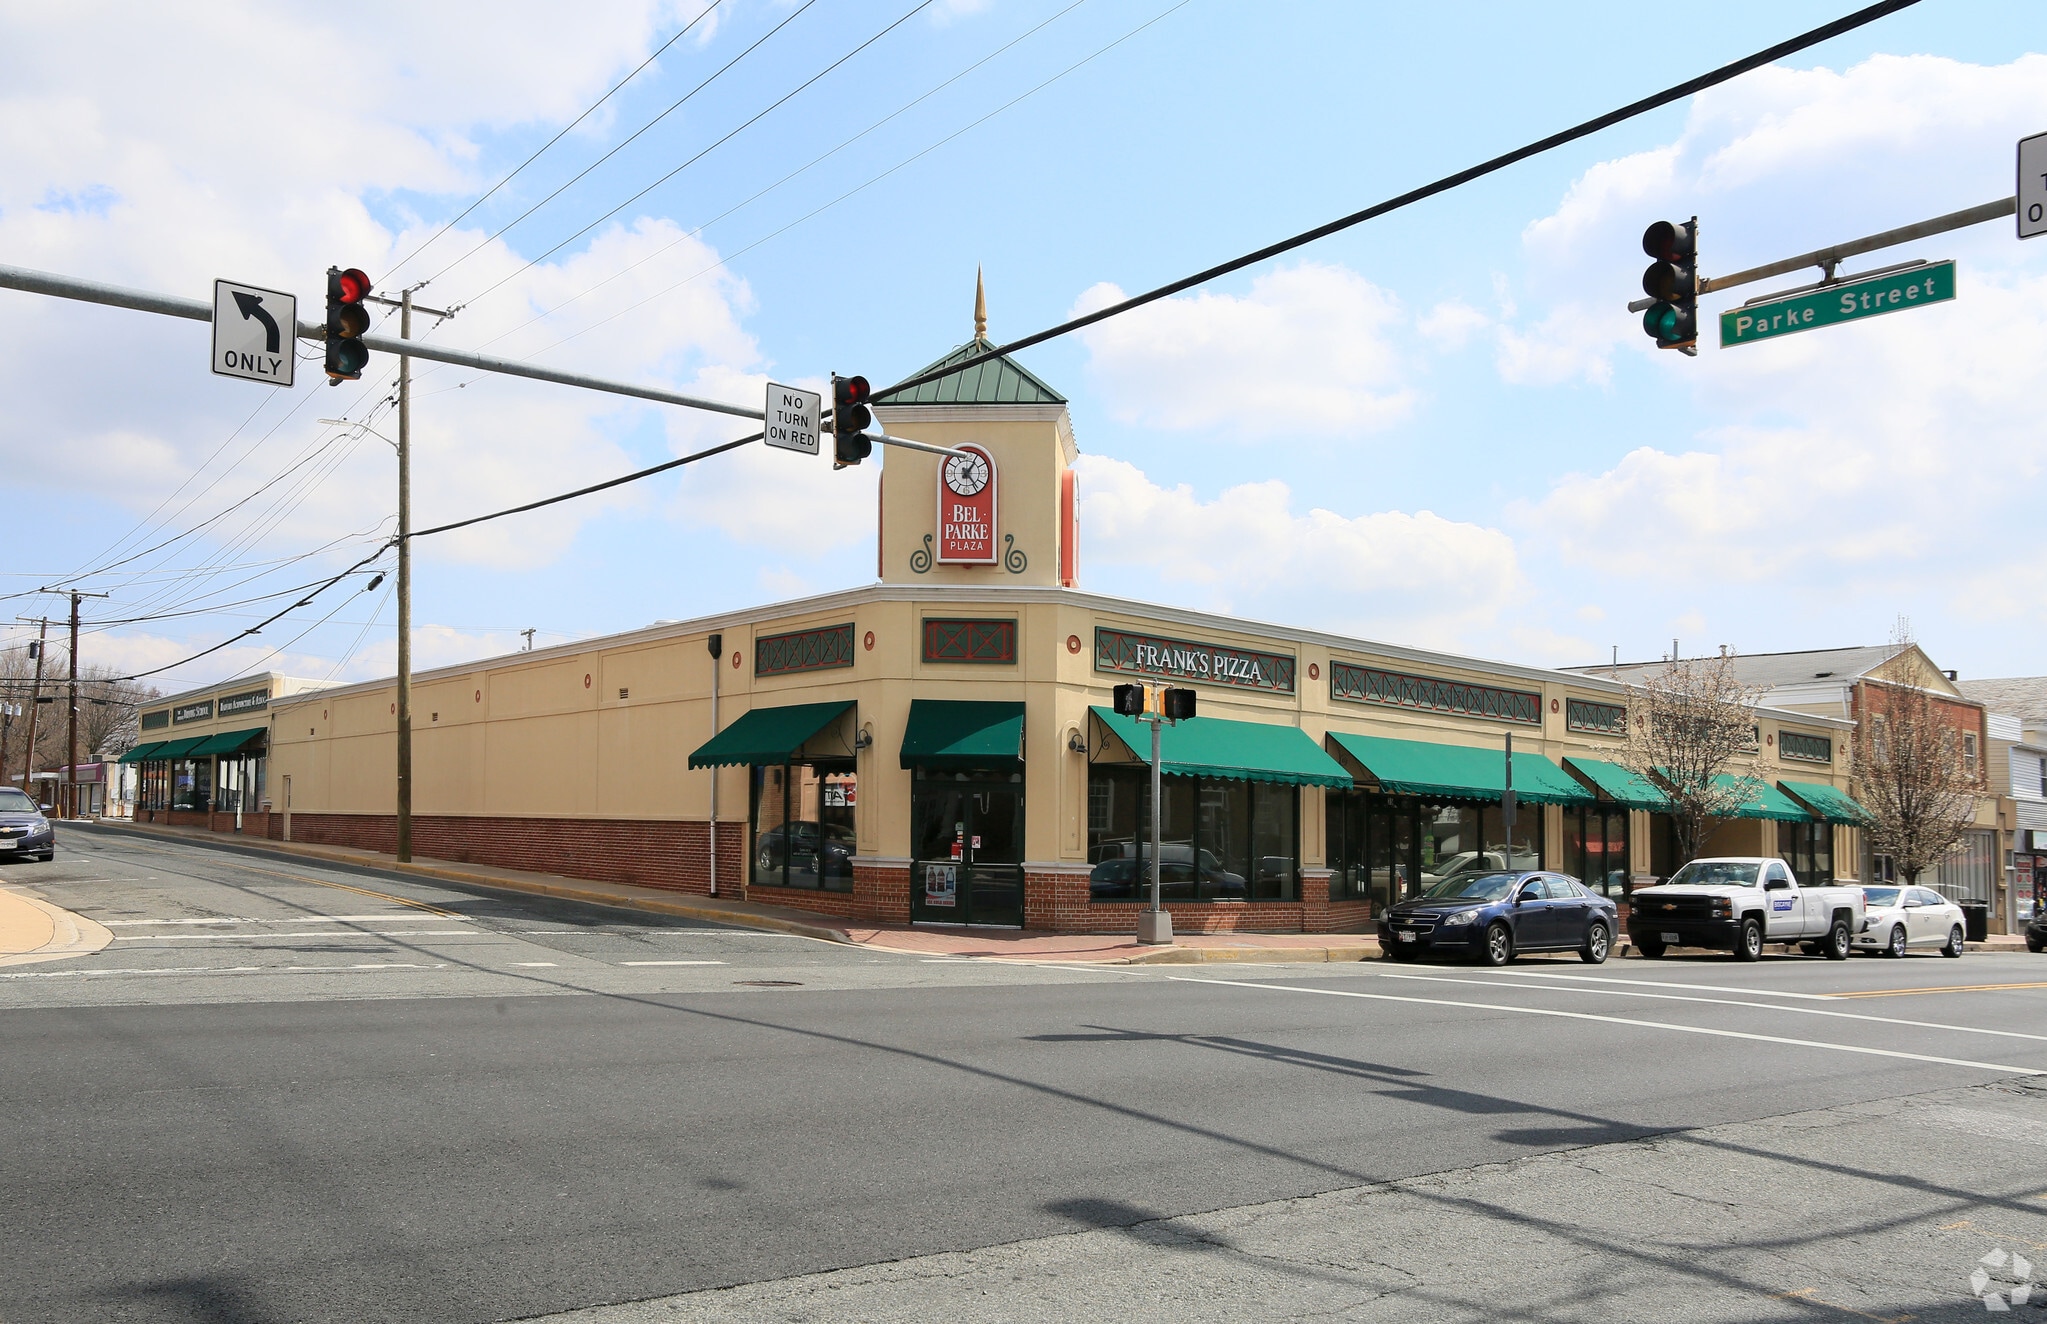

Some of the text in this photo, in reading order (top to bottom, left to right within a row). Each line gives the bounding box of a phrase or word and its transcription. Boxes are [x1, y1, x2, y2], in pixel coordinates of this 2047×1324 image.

[1735, 277, 1935, 337] Parke Street
[224, 350, 282, 376] ONLY
[783, 394, 803, 409] NO
[777, 410, 808, 428] TURN
[770, 426, 815, 446] ON RED
[953, 504, 981, 522] BEL
[945, 524, 989, 539] PARKE
[950, 541, 984, 550] PLAZA
[1136, 644, 1262, 681] FRANK'S PIZZA
